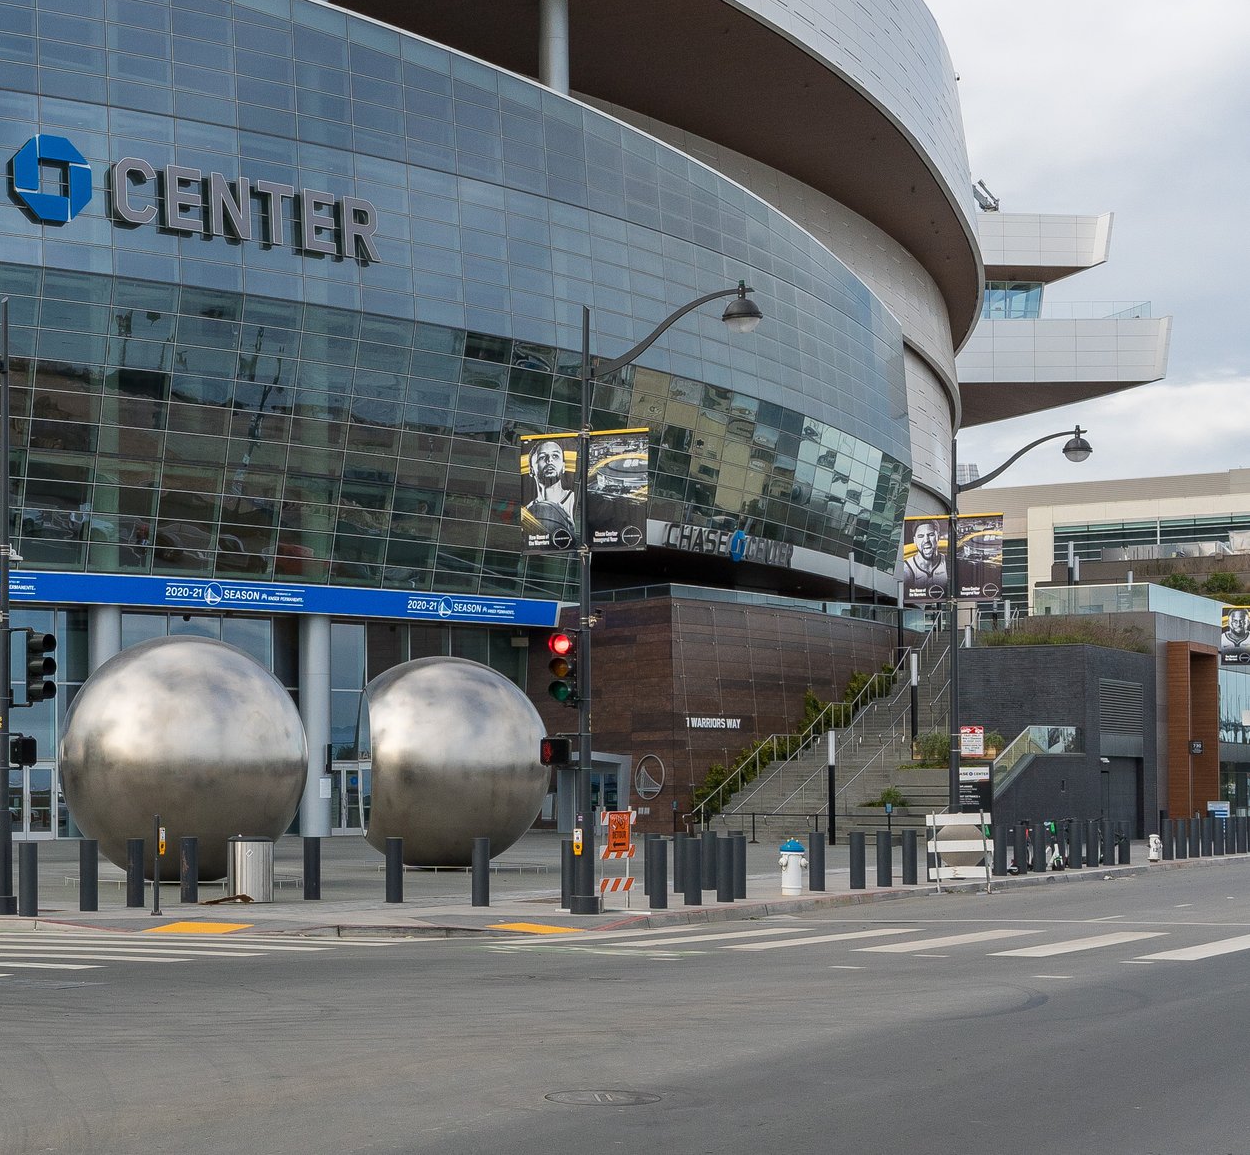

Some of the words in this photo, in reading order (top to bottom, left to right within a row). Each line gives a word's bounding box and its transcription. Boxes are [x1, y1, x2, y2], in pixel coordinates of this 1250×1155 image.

[111, 157, 381, 263] CENTER
[664, 523, 730, 556] CHASE
[746, 536, 793, 568] CENTER
[165, 587, 202, 597] 2020-21
[224, 590, 260, 600] SEASON
[407, 600, 437, 610] 2020-21
[453, 603, 482, 613] SEASON
[686, 717, 689, 727] 1
[691, 717, 725, 728] WARRIORS
[726, 718, 741, 729] WAY
